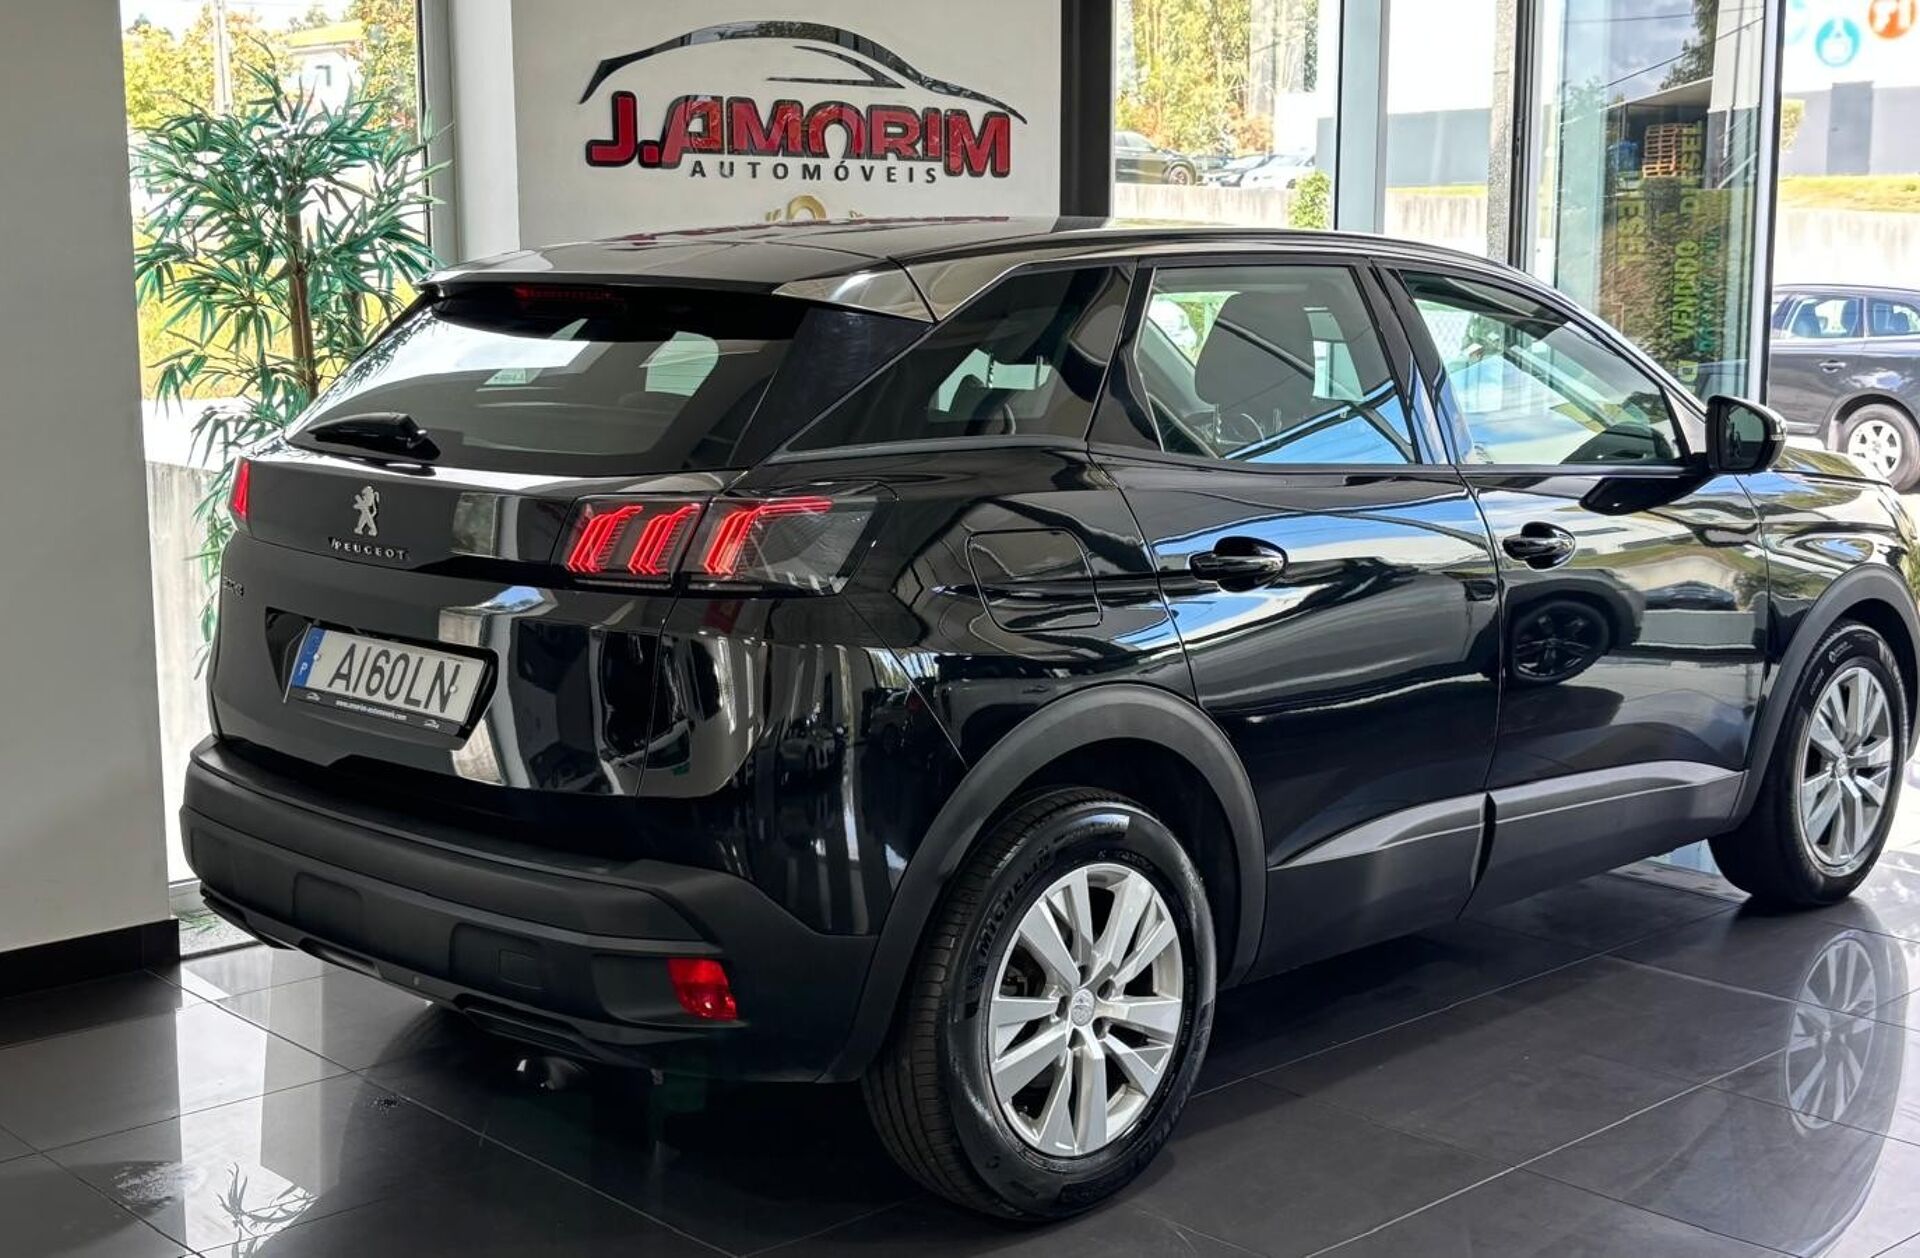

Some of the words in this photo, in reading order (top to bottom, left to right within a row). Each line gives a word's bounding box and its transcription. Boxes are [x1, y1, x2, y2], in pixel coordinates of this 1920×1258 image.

[584, 91, 1011, 178] J.AMORIM
[690, 159, 937, 183] AUTOMÓVEIS
[1672, 240, 1699, 341] VENDIDO
[333, 539, 406, 560] PEUGEOT
[327, 643, 461, 713] AI60LN
